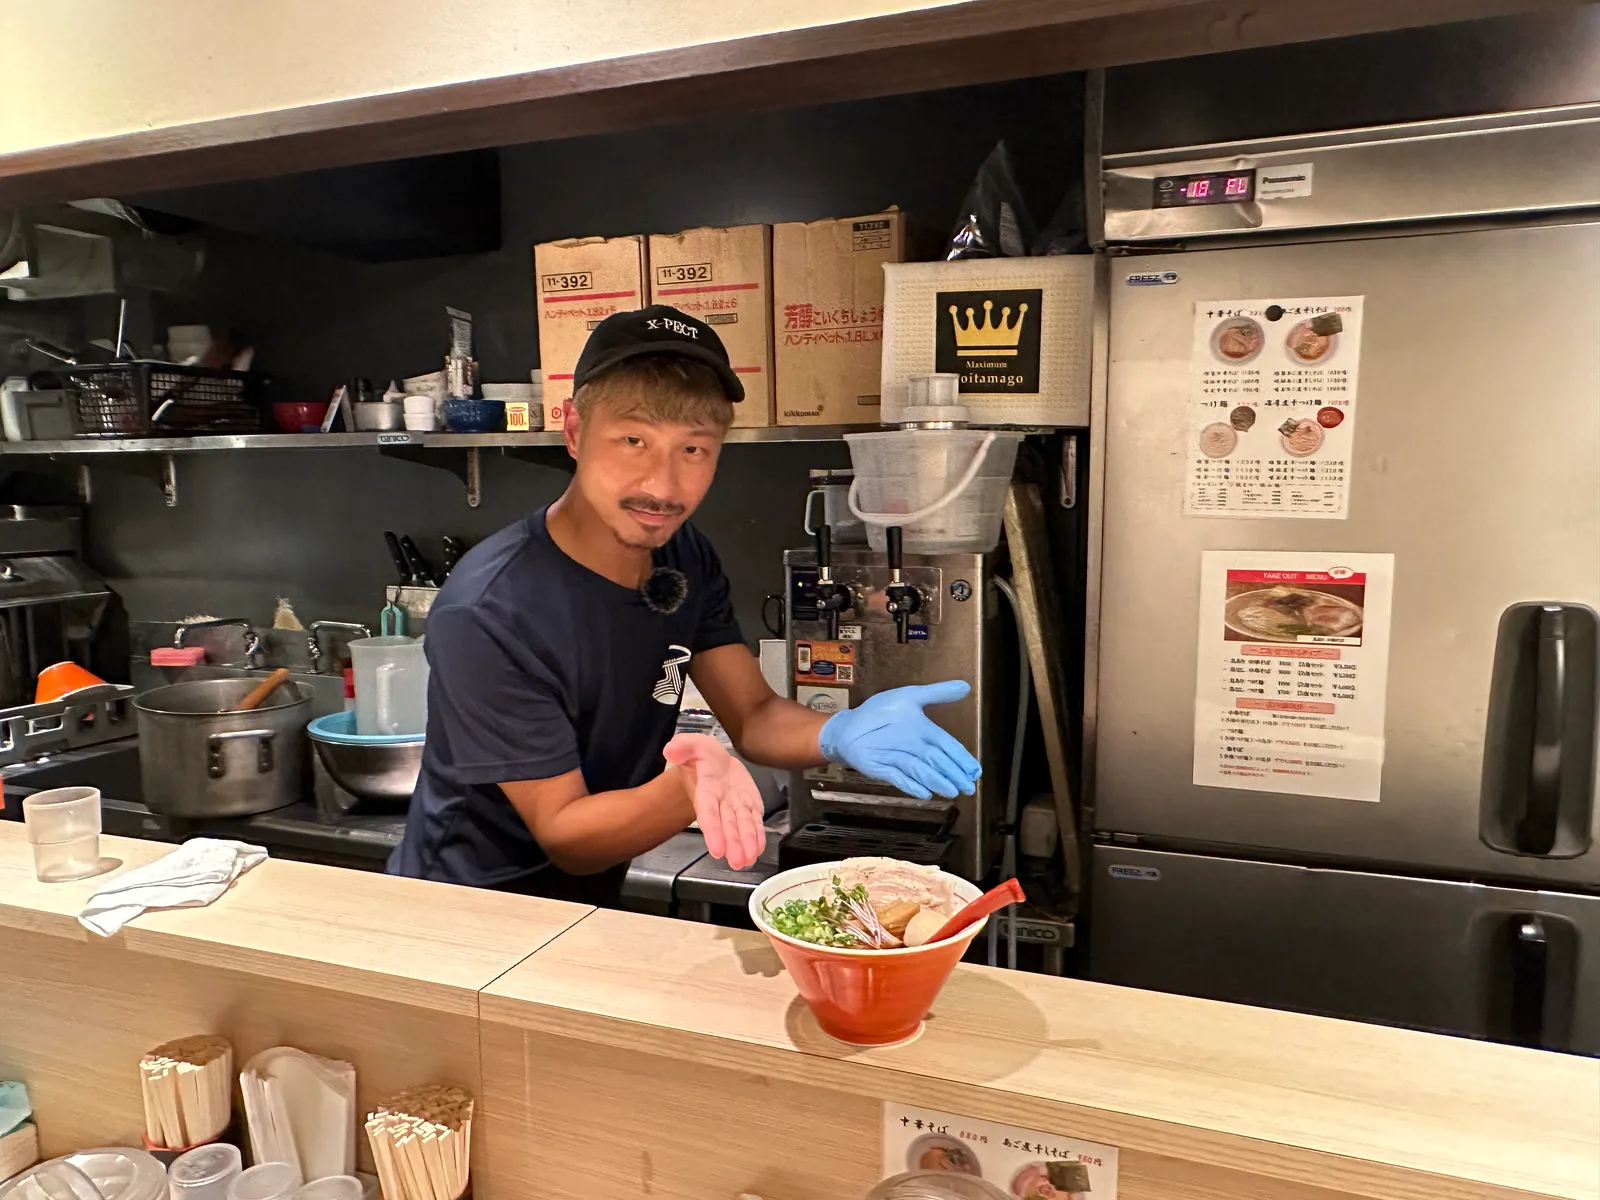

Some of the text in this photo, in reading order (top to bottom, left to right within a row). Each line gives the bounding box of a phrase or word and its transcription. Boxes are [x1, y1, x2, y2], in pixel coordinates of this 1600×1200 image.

[1262, 174, 1306, 184] Panasonic
[661, 266, 708, 281] 11-392
[547, 274, 588, 288] 11-392
[646, 317, 699, 340] X-PECT
[966, 361, 1007, 369] Maximum
[960, 373, 1023, 386] oitamago
[900, 1116, 949, 1134] 中華そば
[1002, 1137, 1071, 1159] あご煮干しそば
